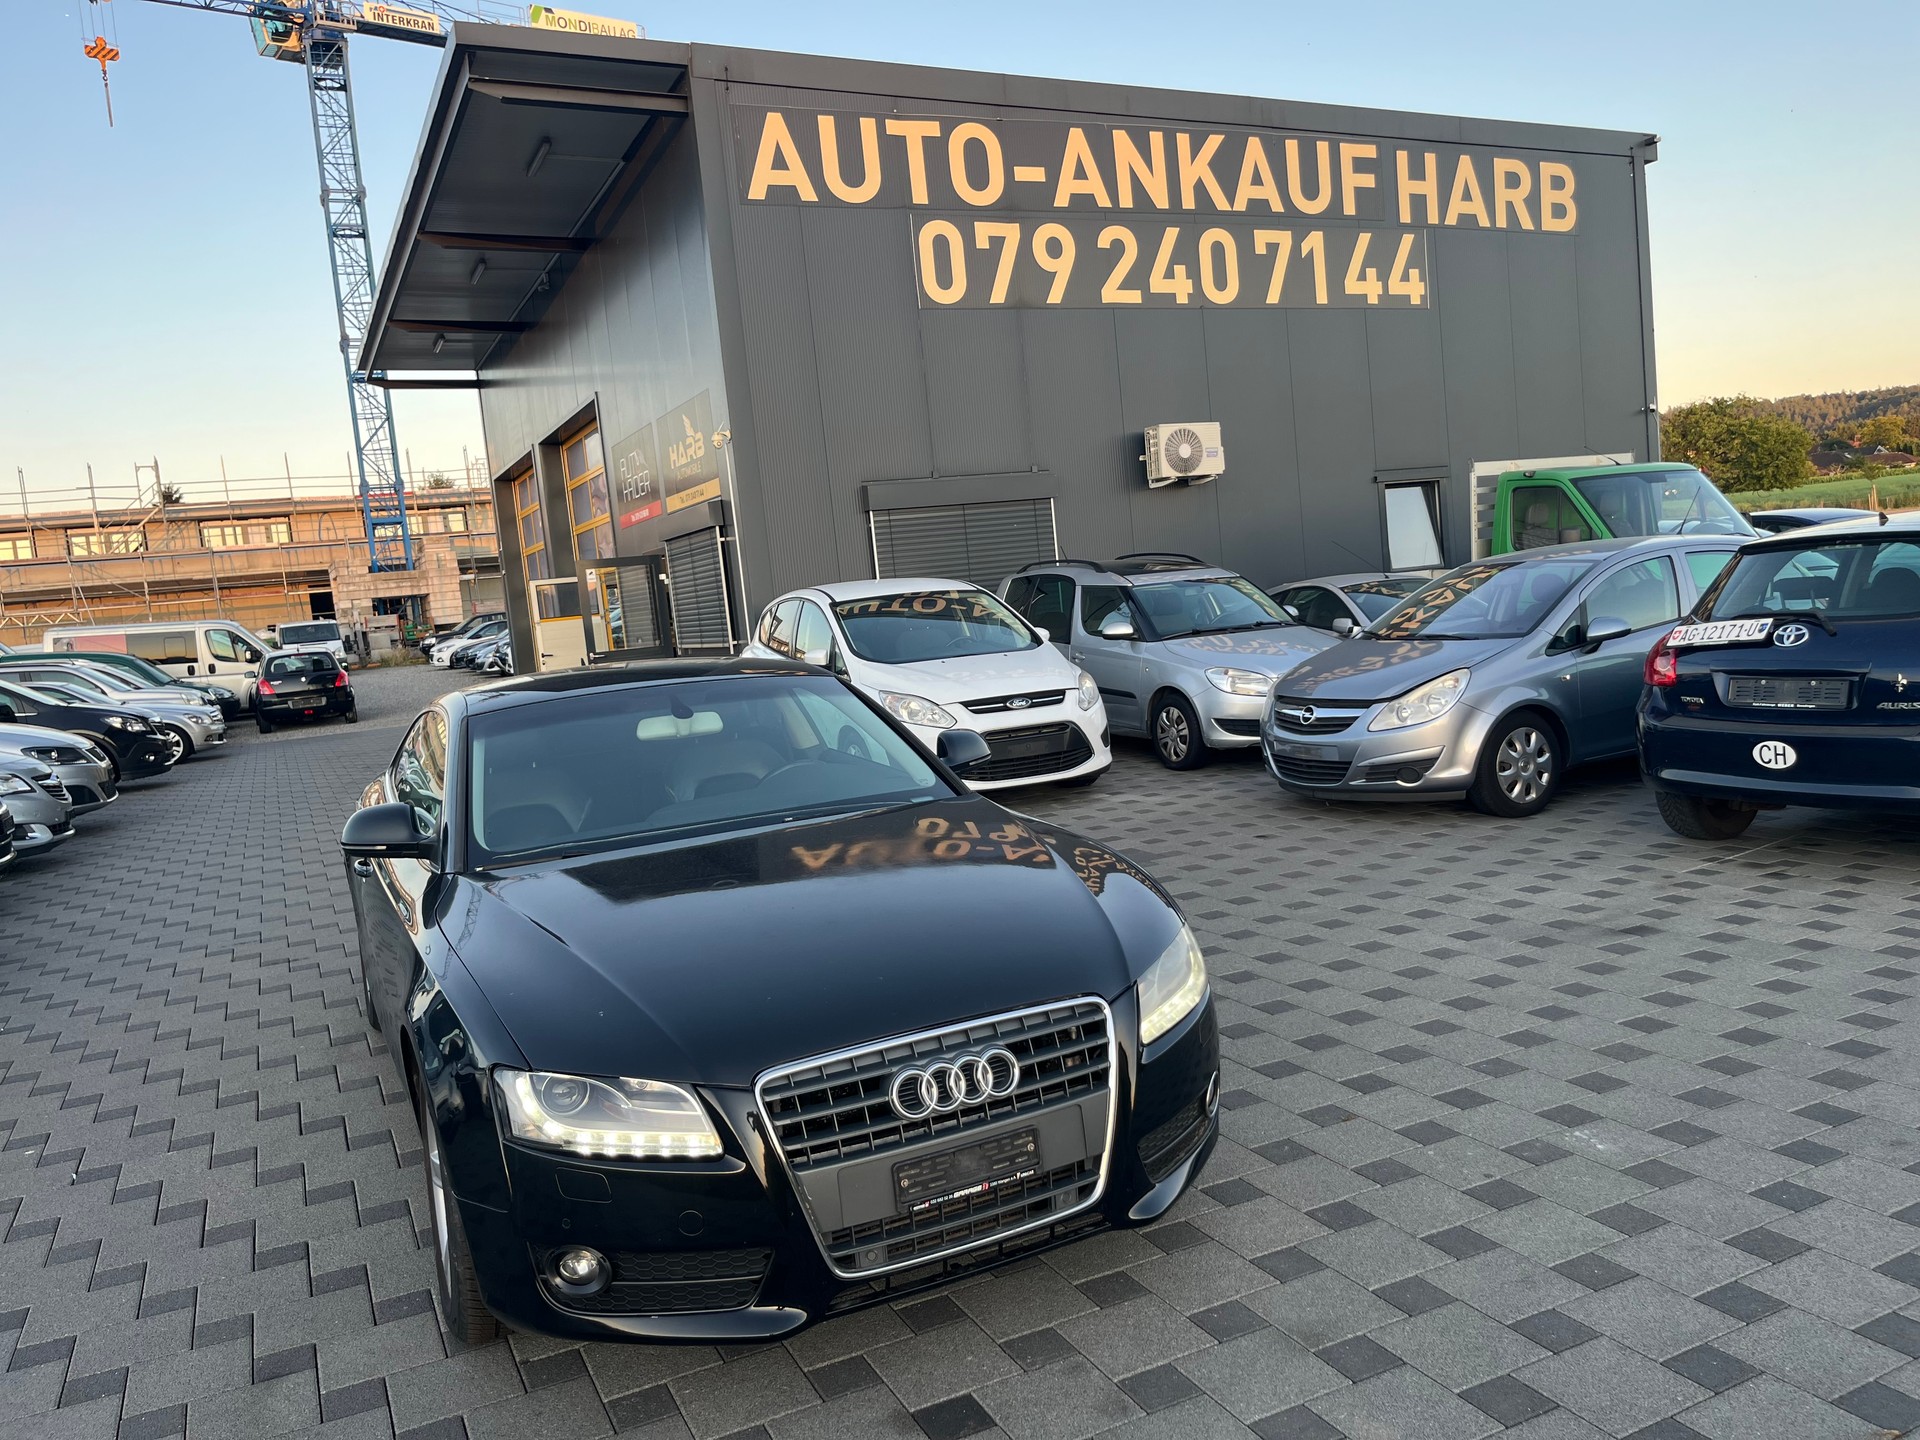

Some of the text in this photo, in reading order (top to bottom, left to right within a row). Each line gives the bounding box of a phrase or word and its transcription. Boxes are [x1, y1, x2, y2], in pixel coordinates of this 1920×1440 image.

[372, 11, 435, 32] INTERKRAN
[748, 112, 1577, 232] AUTO-ANKAUF HARB
[919, 220, 1076, 305] 079
[1098, 226, 1240, 305] 240
[1345, 233, 1425, 305] 44
[669, 431, 705, 470] HARB
[1759, 744, 1787, 765] CH
